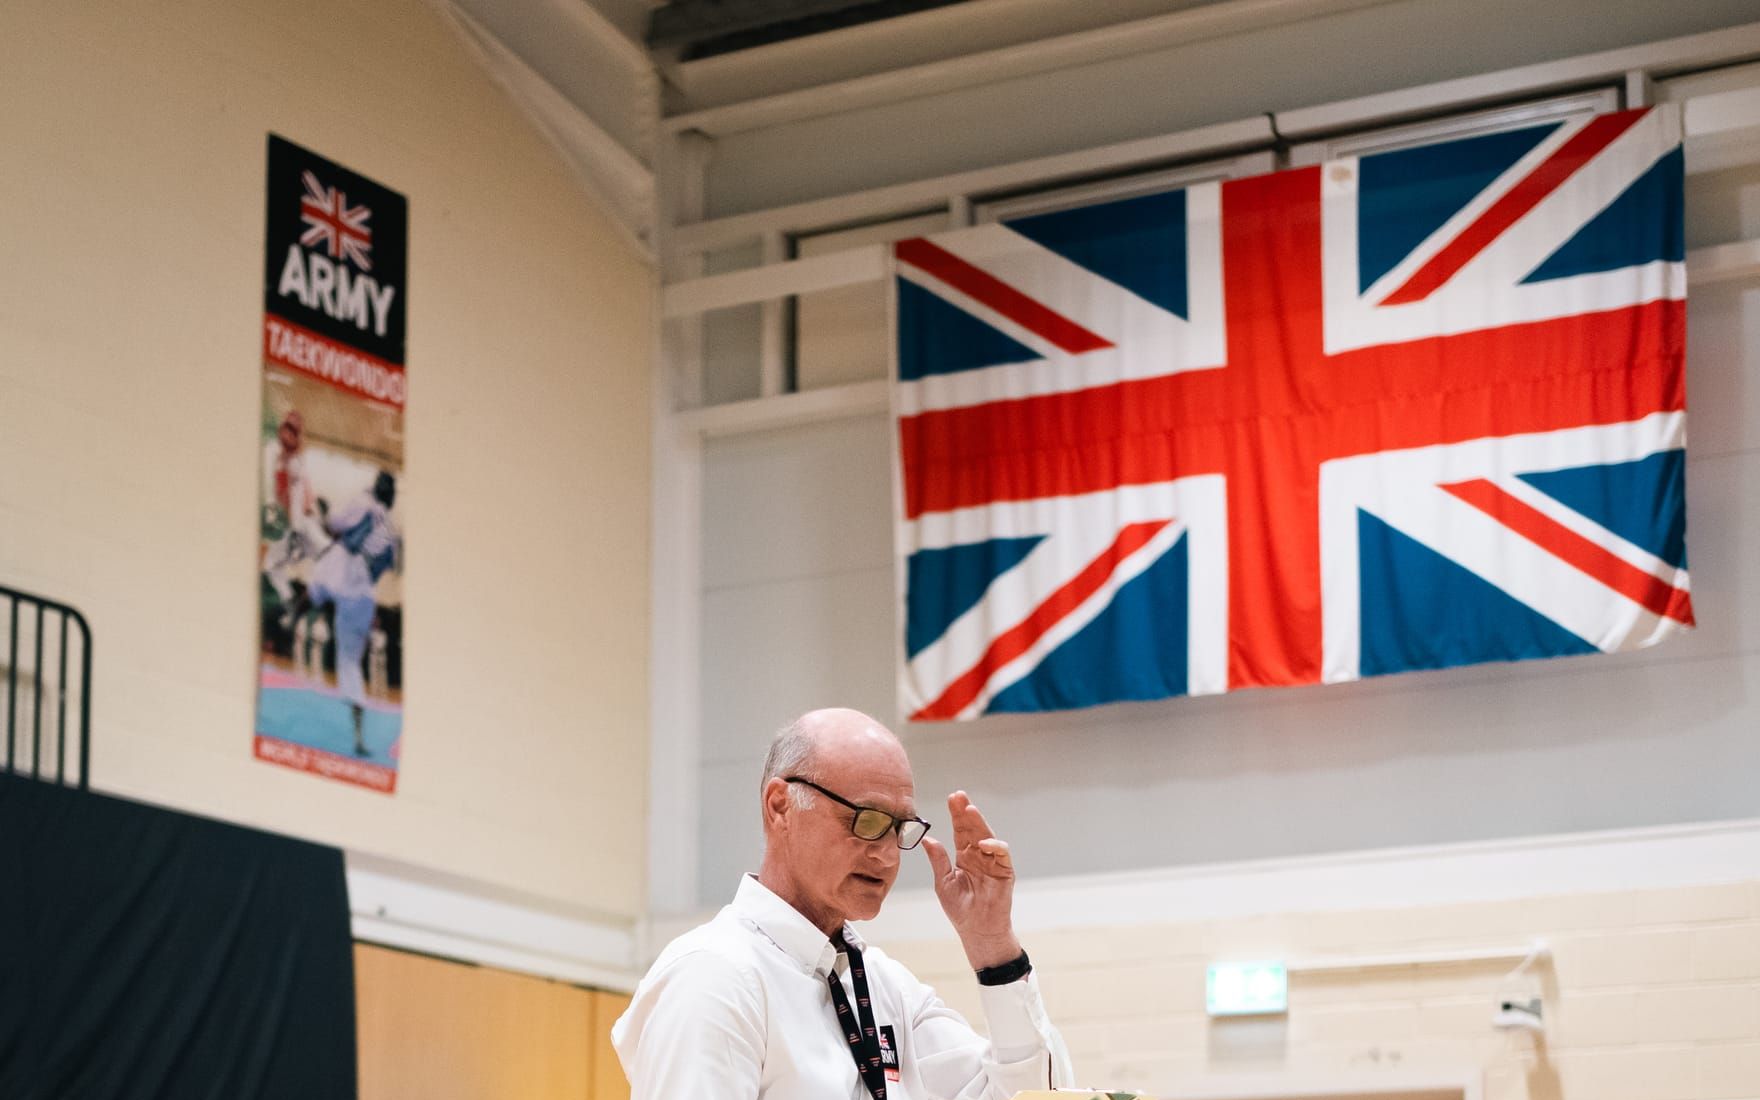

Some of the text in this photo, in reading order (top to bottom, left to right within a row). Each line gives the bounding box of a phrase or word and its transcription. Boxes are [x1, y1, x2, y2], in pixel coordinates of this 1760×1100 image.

[278, 244, 395, 336] ARMY
[267, 321, 405, 404] TAEKWONDO
[880, 1049, 897, 1065] RMY
